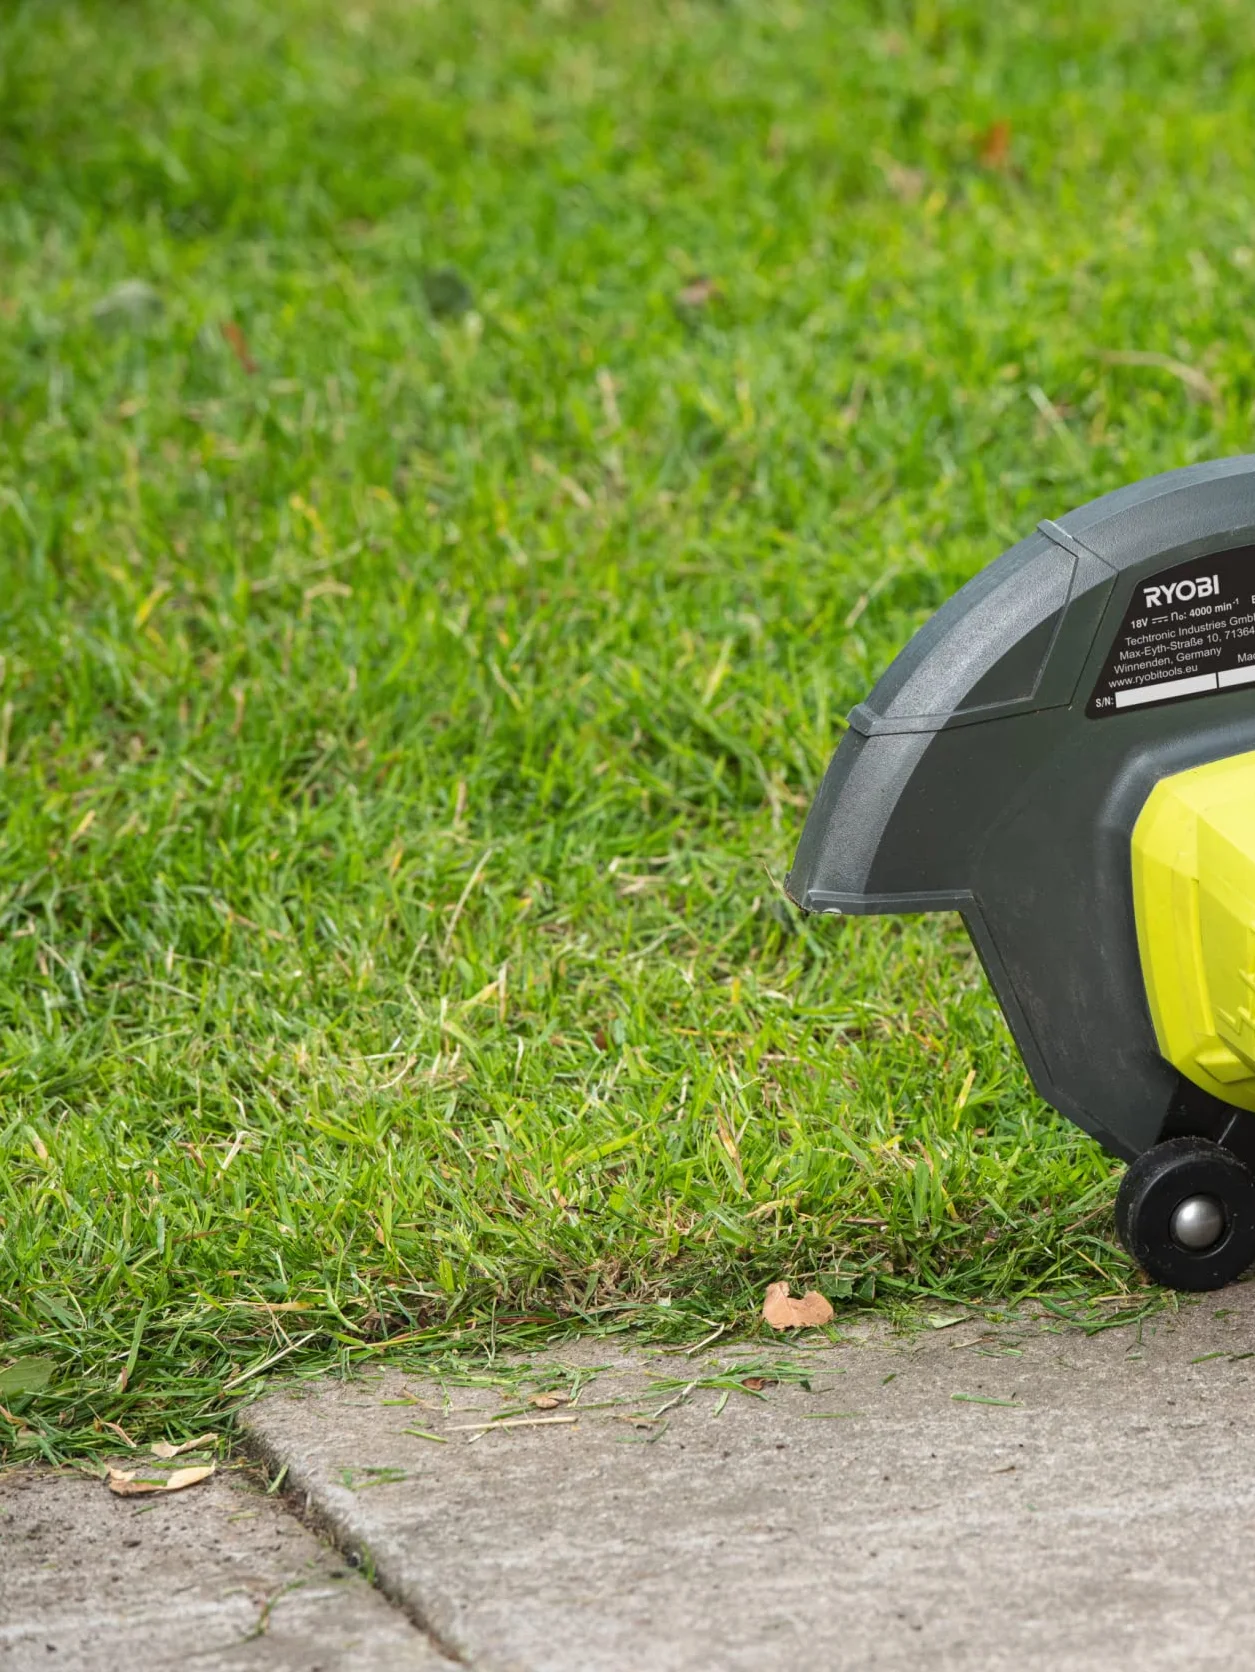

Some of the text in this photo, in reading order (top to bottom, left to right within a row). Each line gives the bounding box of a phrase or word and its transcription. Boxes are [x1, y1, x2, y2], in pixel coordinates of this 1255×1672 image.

[1143, 574, 1220, 608] RYOBI
[1131, 617, 1148, 629] 18V
[1189, 607, 1212, 618] 4000
[1119, 626, 1255, 661] Max-Eyth-Straße 10, 71364
[1125, 628, 1176, 646] Techtronic
[1178, 619, 1227, 636] Industries
[1113, 647, 1222, 675] Winnenden, Germany
[1108, 664, 1198, 688] www.ryobitools.eu
[1095, 697, 1114, 708] S/N:
